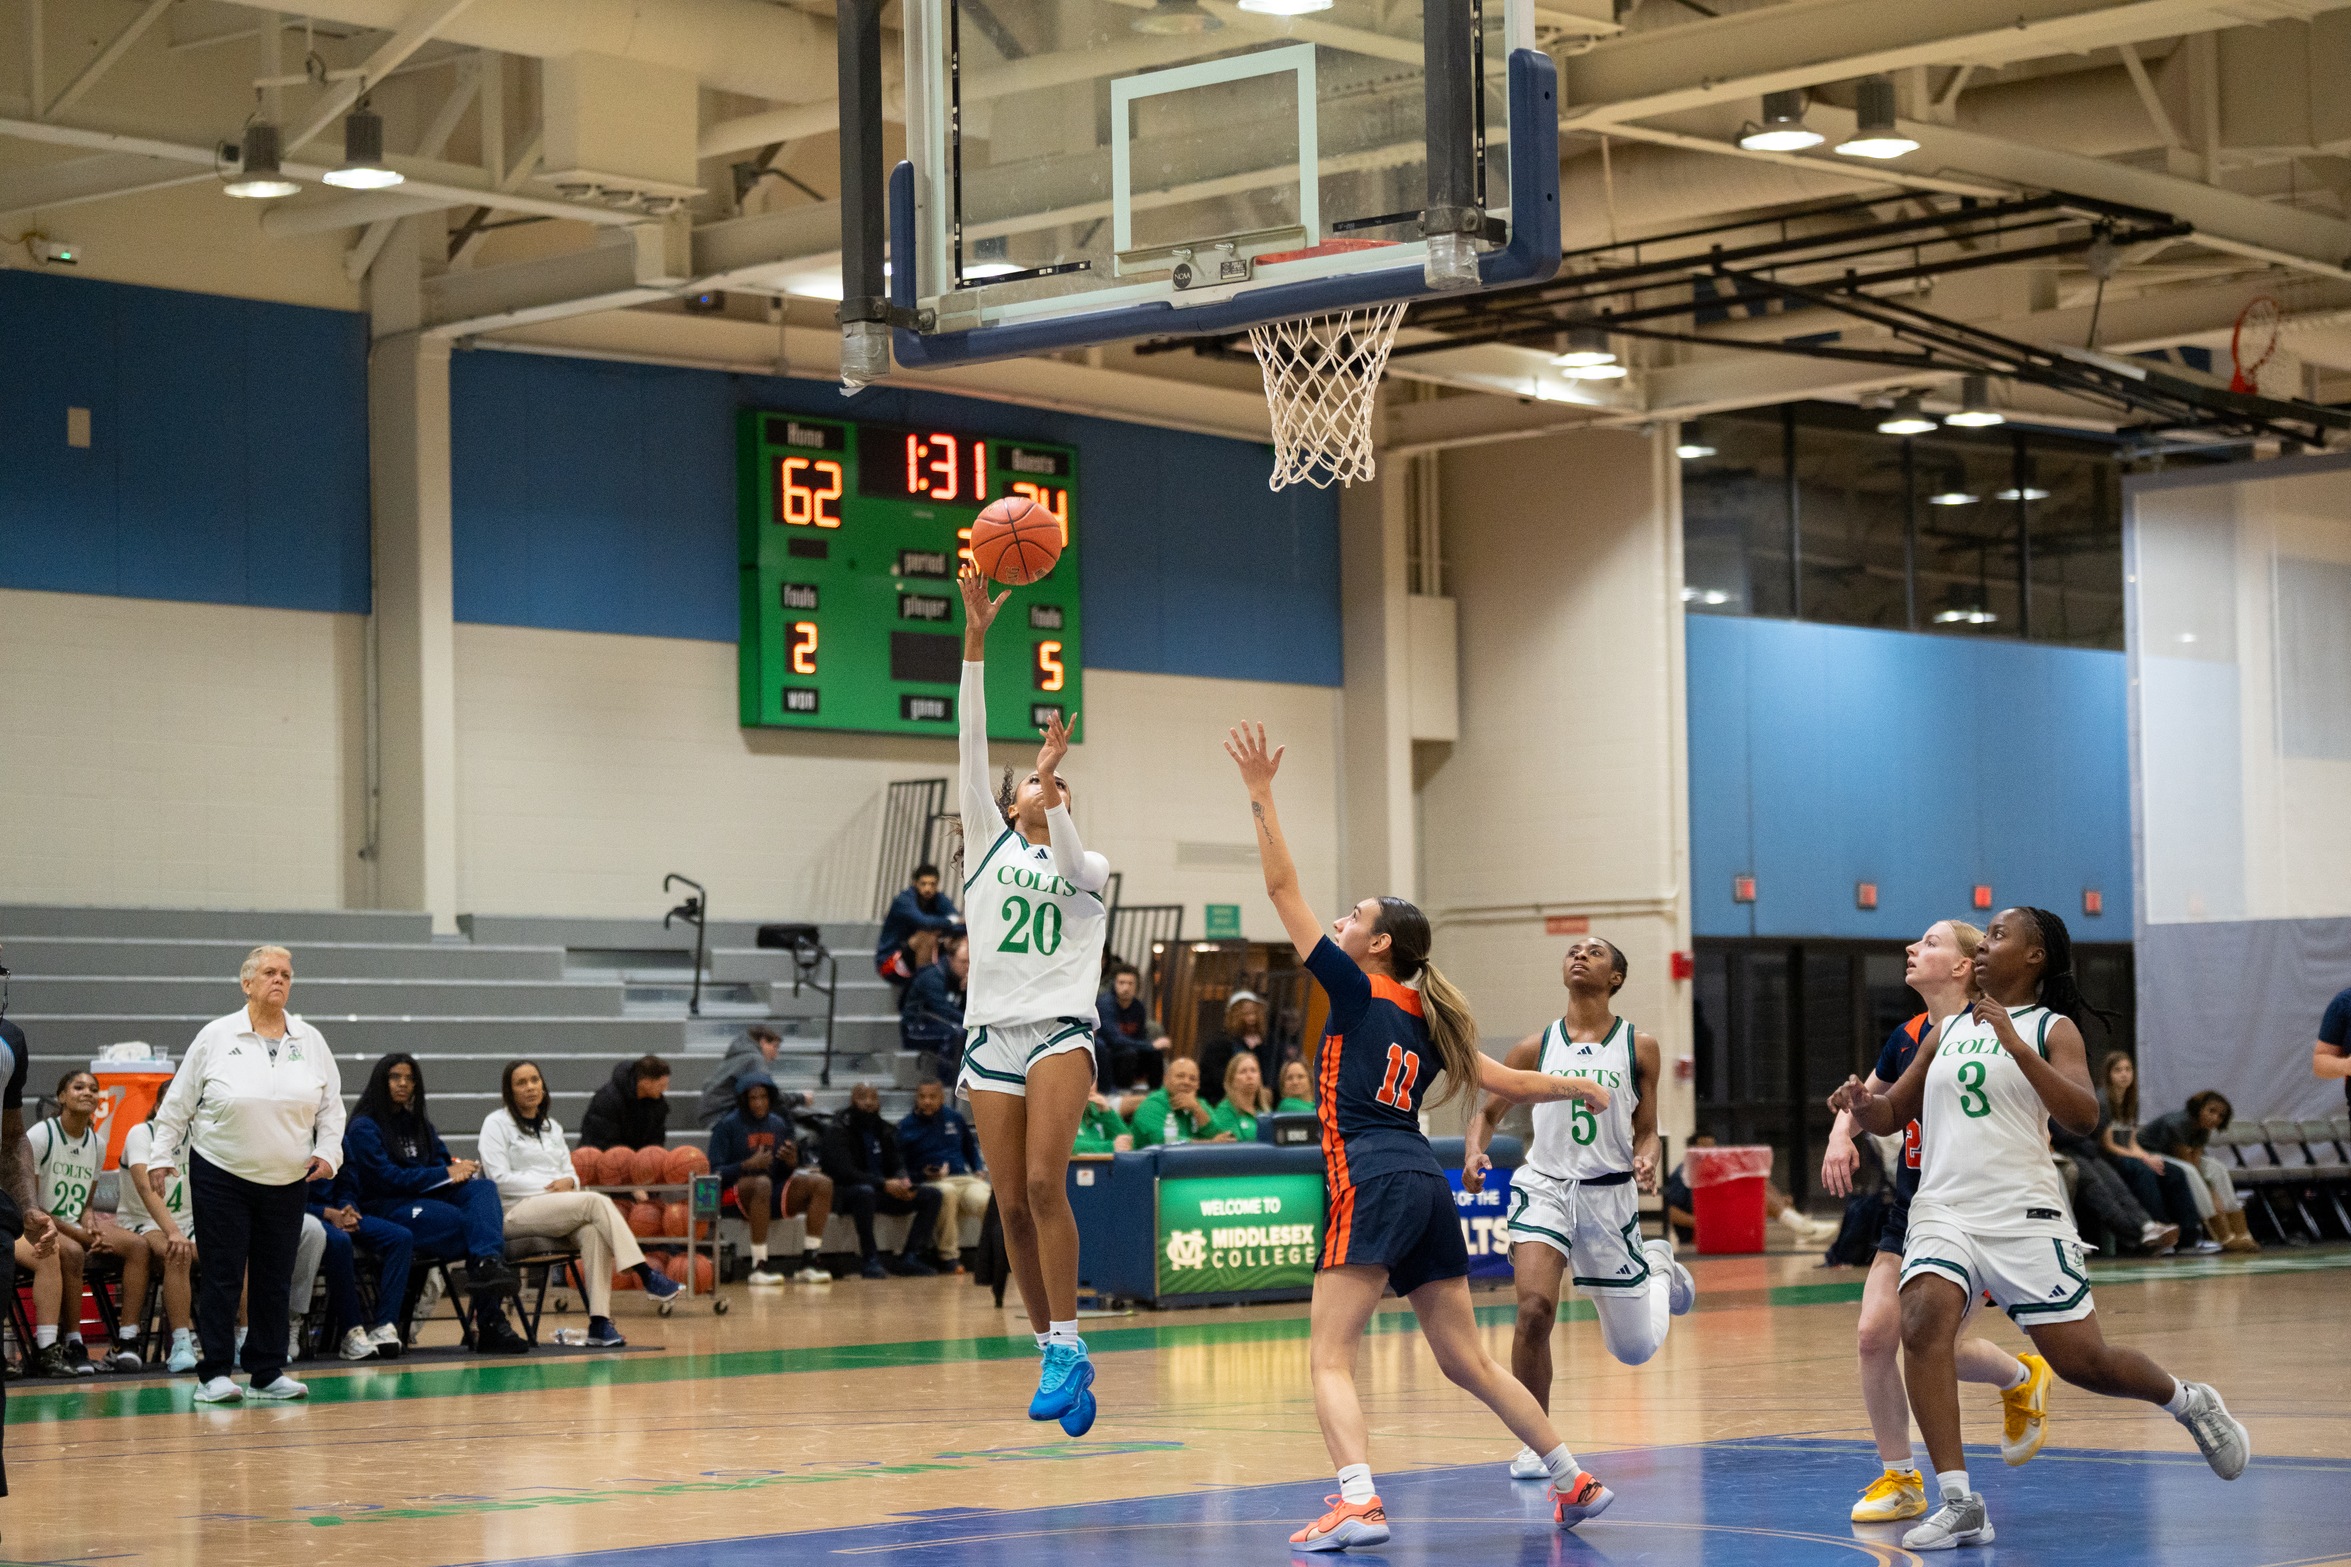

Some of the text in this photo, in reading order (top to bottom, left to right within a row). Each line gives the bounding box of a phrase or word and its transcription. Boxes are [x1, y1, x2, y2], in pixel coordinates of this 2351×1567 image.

[907, 433, 987, 501] 1:31
[782, 457, 843, 528] 62
[904, 553, 946, 575] period
[793, 621, 818, 674] 2
[1039, 641, 1064, 691] 5
[787, 691, 816, 710] won
[910, 699, 945, 720] game
[997, 865, 1077, 897] COLTS
[996, 895, 1062, 956] 20
[1375, 1042, 1420, 1112] 11
[1957, 1061, 1991, 1119] 3
[1571, 1098, 1597, 1146] 5
[52, 1161, 93, 1179] COLTS
[51, 1181, 87, 1217] 23
[166, 1181, 183, 1213] 4
[1200, 1197, 1281, 1217] WELCOME TO
[1457, 1189, 1475, 1207] OF
[1476, 1188, 1500, 1206] THE
[1211, 1224, 1315, 1249] MIDDLESEX
[1460, 1216, 1511, 1255] LTS
[1211, 1246, 1316, 1268] COLLEGE
